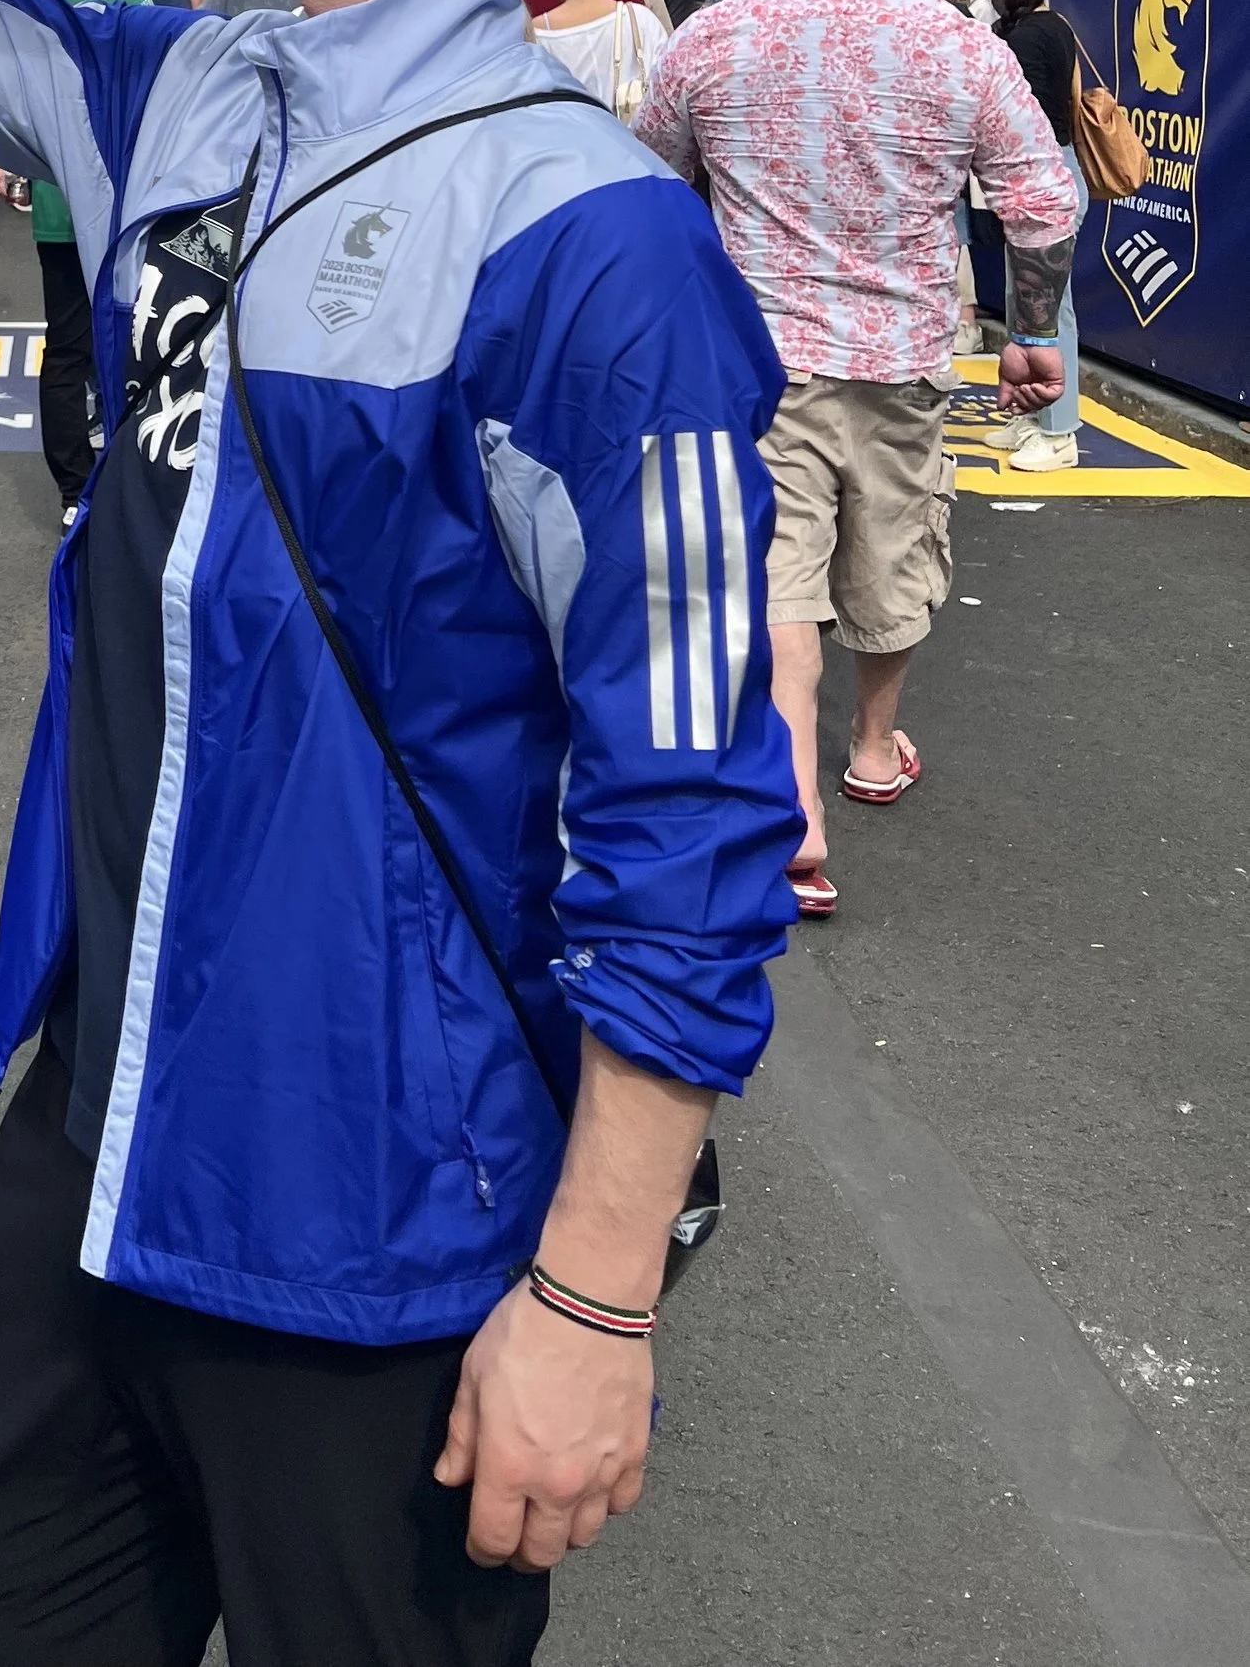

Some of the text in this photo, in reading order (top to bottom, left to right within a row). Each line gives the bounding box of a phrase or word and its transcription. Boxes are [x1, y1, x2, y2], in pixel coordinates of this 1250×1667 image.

[1146, 156, 1190, 193] ATHON
[1136, 197, 1149, 213] OF
[1146, 200, 1191, 224] AMERICA
[322, 258, 384, 278] 2025 BOSTON
[318, 271, 380, 291] MARATHON
